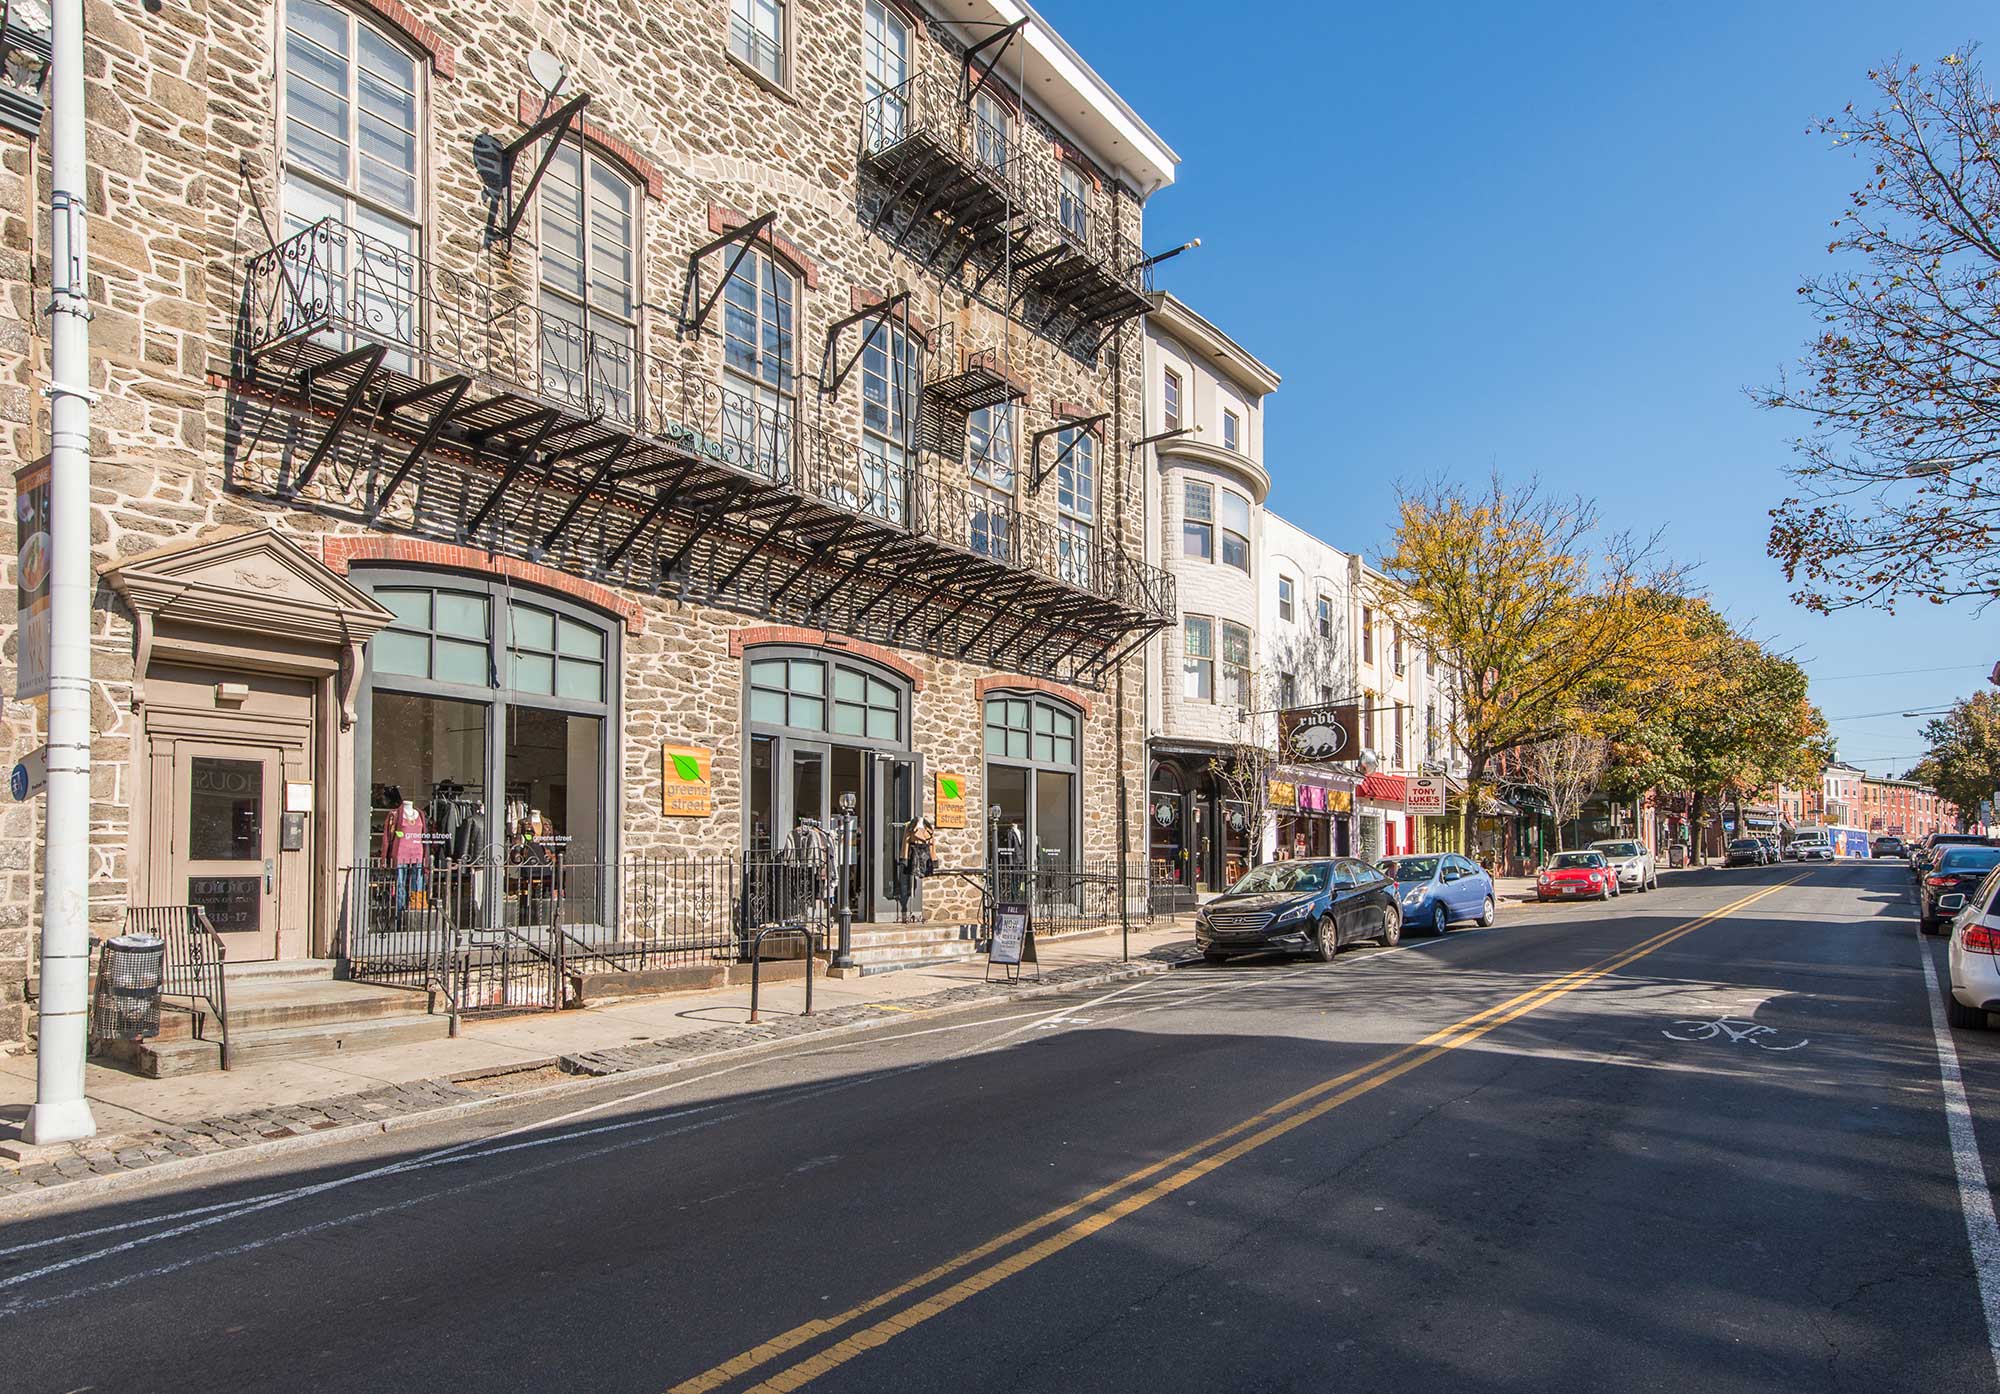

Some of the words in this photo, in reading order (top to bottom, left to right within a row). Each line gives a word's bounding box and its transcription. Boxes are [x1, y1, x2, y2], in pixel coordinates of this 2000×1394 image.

[1299, 709, 1335, 726] rubb
[667, 785, 708, 797] greene
[1412, 788, 1436, 796] TONY
[671, 798, 705, 811] street
[941, 815, 962, 824] street
[405, 832, 431, 840] greene
[432, 832, 453, 840] street
